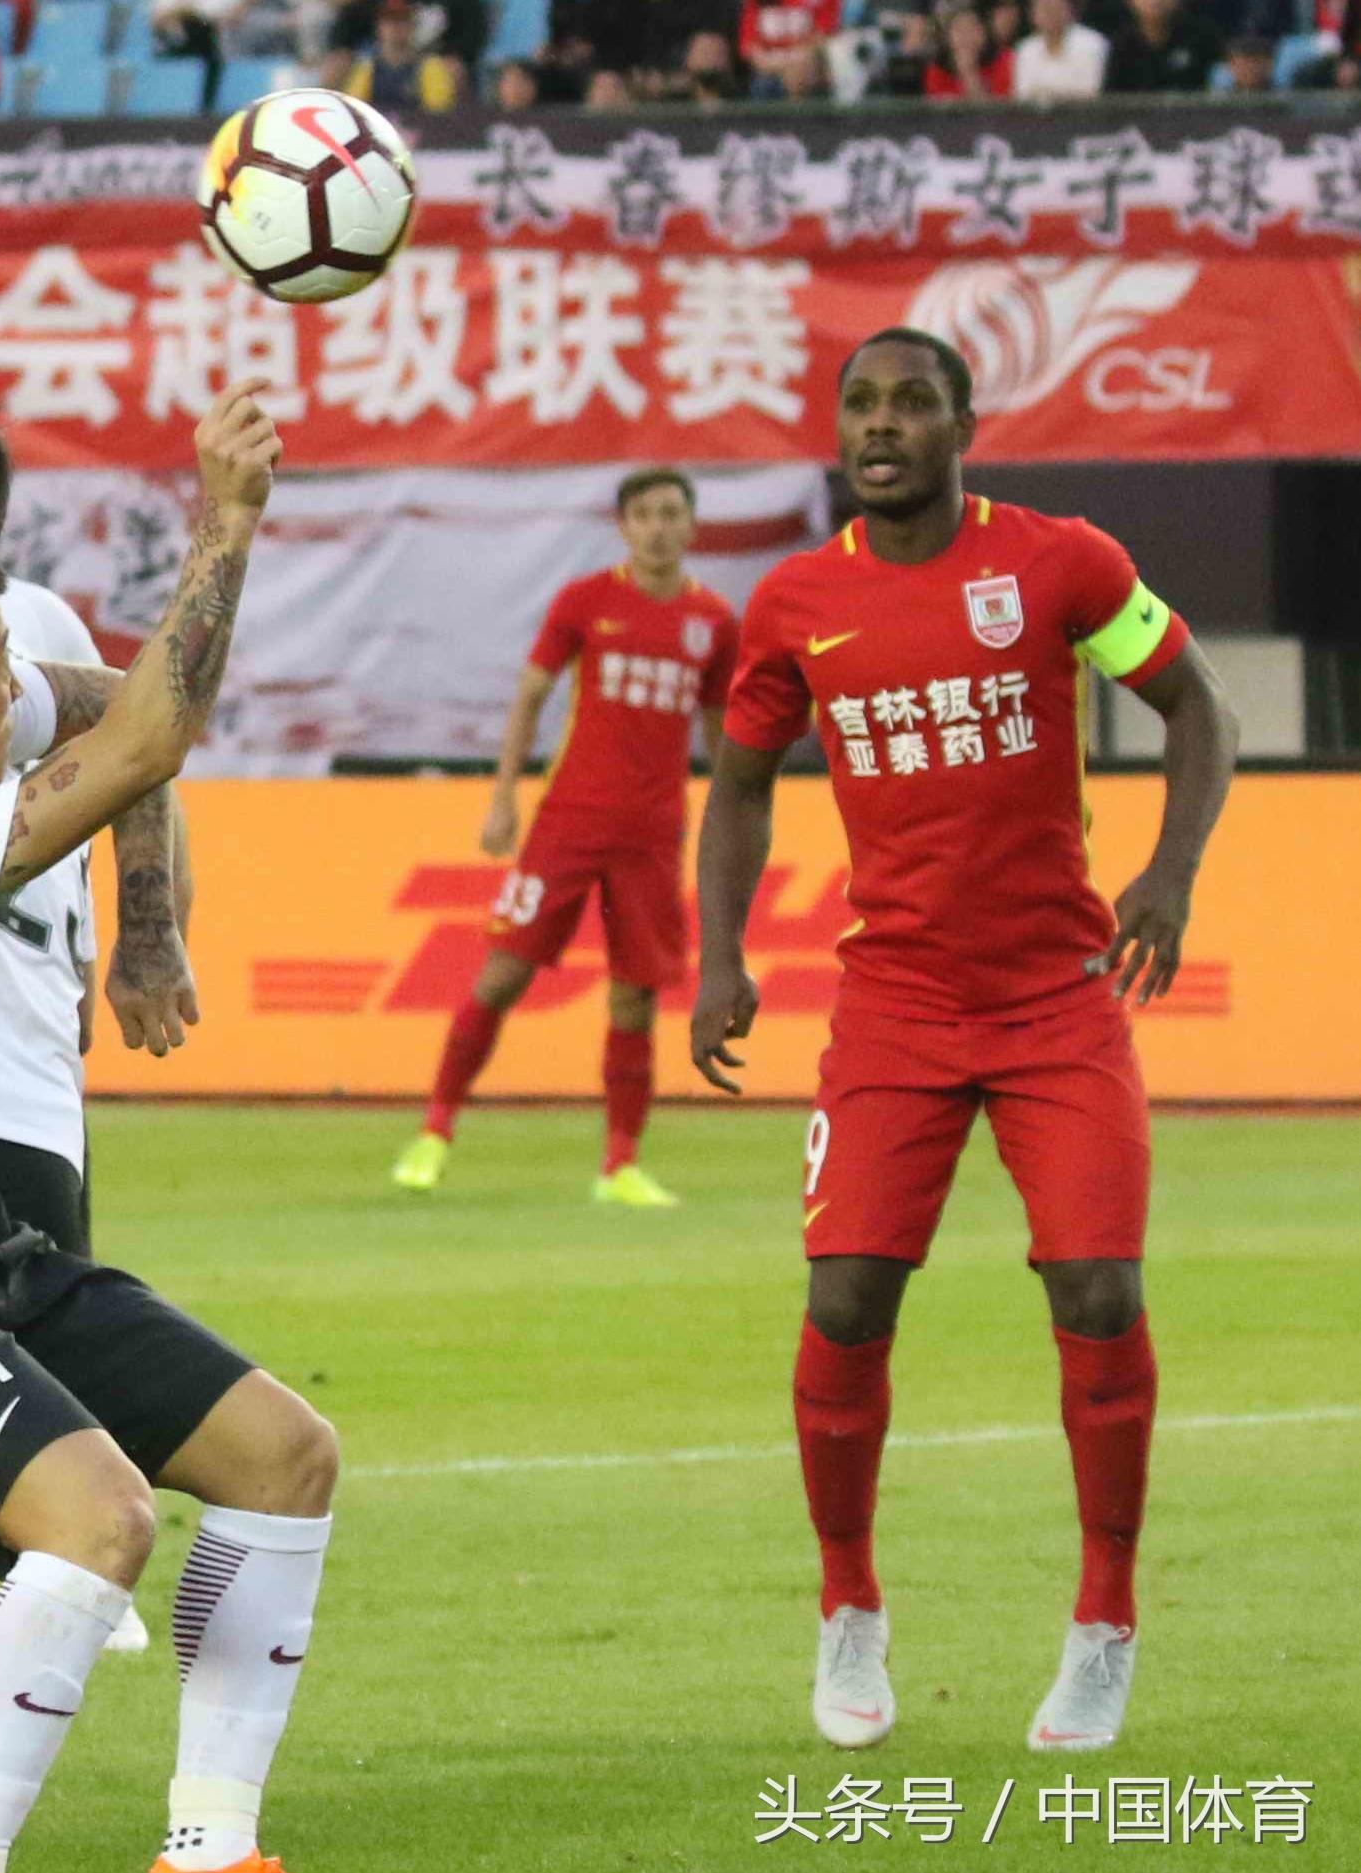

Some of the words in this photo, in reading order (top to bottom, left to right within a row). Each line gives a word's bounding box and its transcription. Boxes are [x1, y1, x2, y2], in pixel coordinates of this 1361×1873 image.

[1085, 347, 1233, 413] CSL
[828, 670, 1030, 736] 吉林银行
[844, 713, 1038, 777] 亚泰药业
